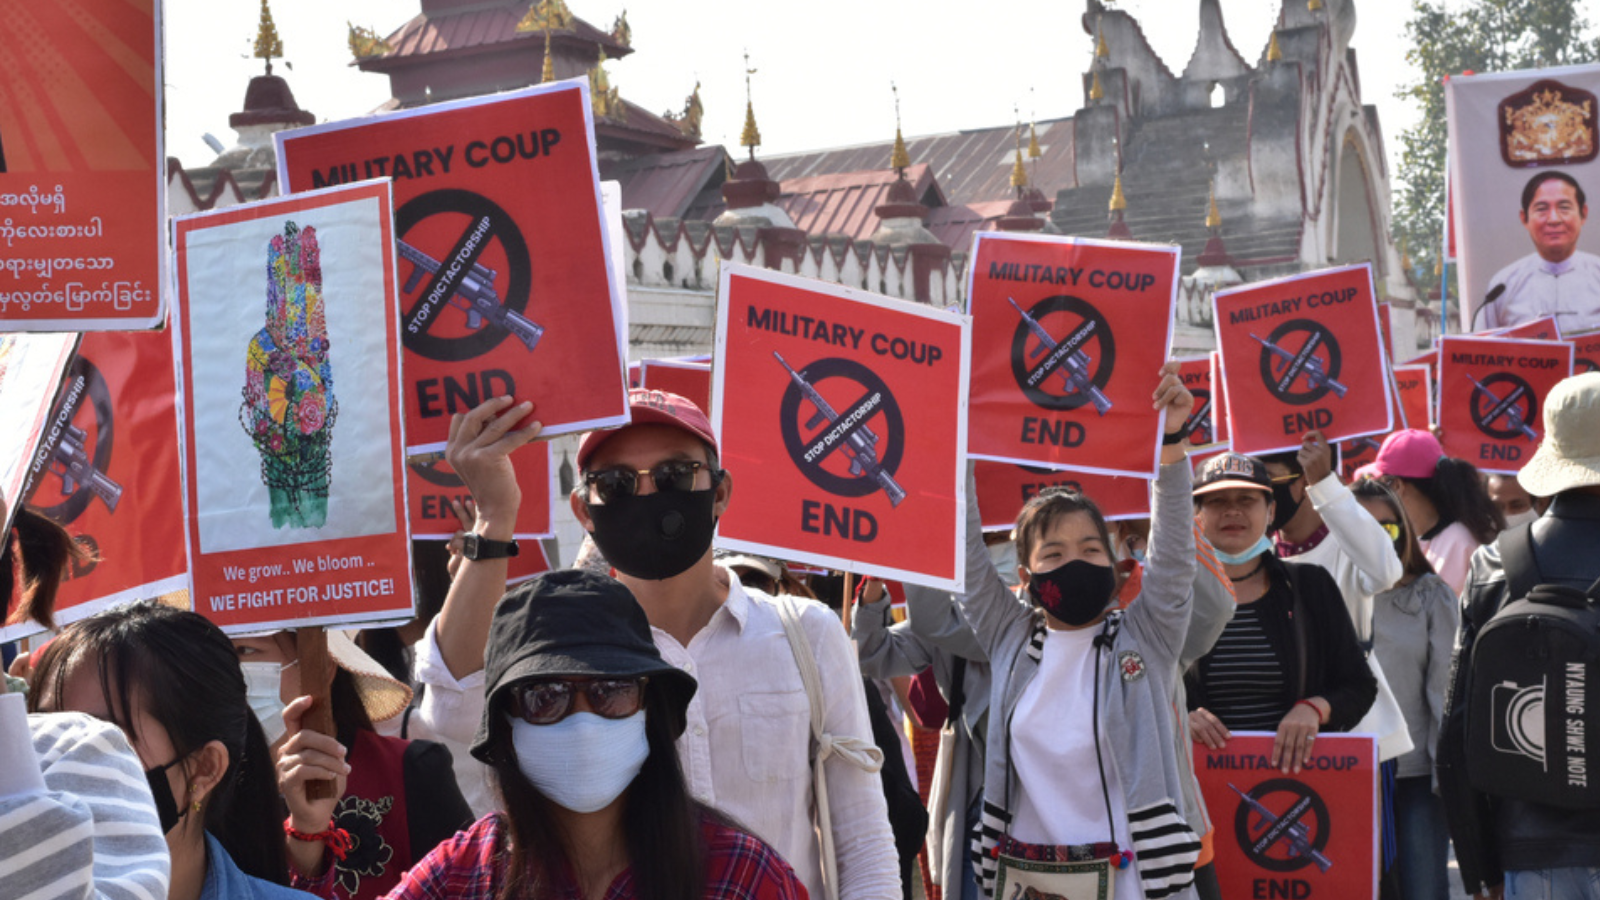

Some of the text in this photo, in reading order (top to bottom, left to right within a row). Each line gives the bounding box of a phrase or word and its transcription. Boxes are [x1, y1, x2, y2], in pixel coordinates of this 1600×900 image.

[464, 128, 561, 168] COUP
[0, 257, 115, 279] ရားမျှတသော
[407, 215, 492, 334] STOP DICTACTORSHIP
[989, 261, 1155, 292] MILITARY COUP
[1229, 287, 1357, 325] MILITARY COUP
[747, 305, 942, 367] MILITARY COUP
[1027, 319, 1096, 387] STOP DICTACTORSHIP
[1452, 353, 1559, 370] MILITARY COUP
[416, 369, 516, 419] END
[1398, 380, 1419, 390] OUP
[804, 392, 882, 463] STOP DICTACTORSHIP
[1020, 416, 1086, 448] END
[1283, 408, 1333, 435] END
[1479, 443, 1521, 461] END
[422, 495, 474, 519] EN
[801, 499, 878, 543] END
[223, 565, 246, 580] We
[248, 563, 290, 583] grow..
[292, 560, 315, 574] We
[318, 555, 363, 571] bloom
[210, 579, 394, 611] WE FIGHT FOR JUSTICE!
[1566, 662, 1587, 787] NYAUNG SHWE NOTE
[1207, 754, 1281, 770] MILITA
[1253, 879, 1311, 899] END
